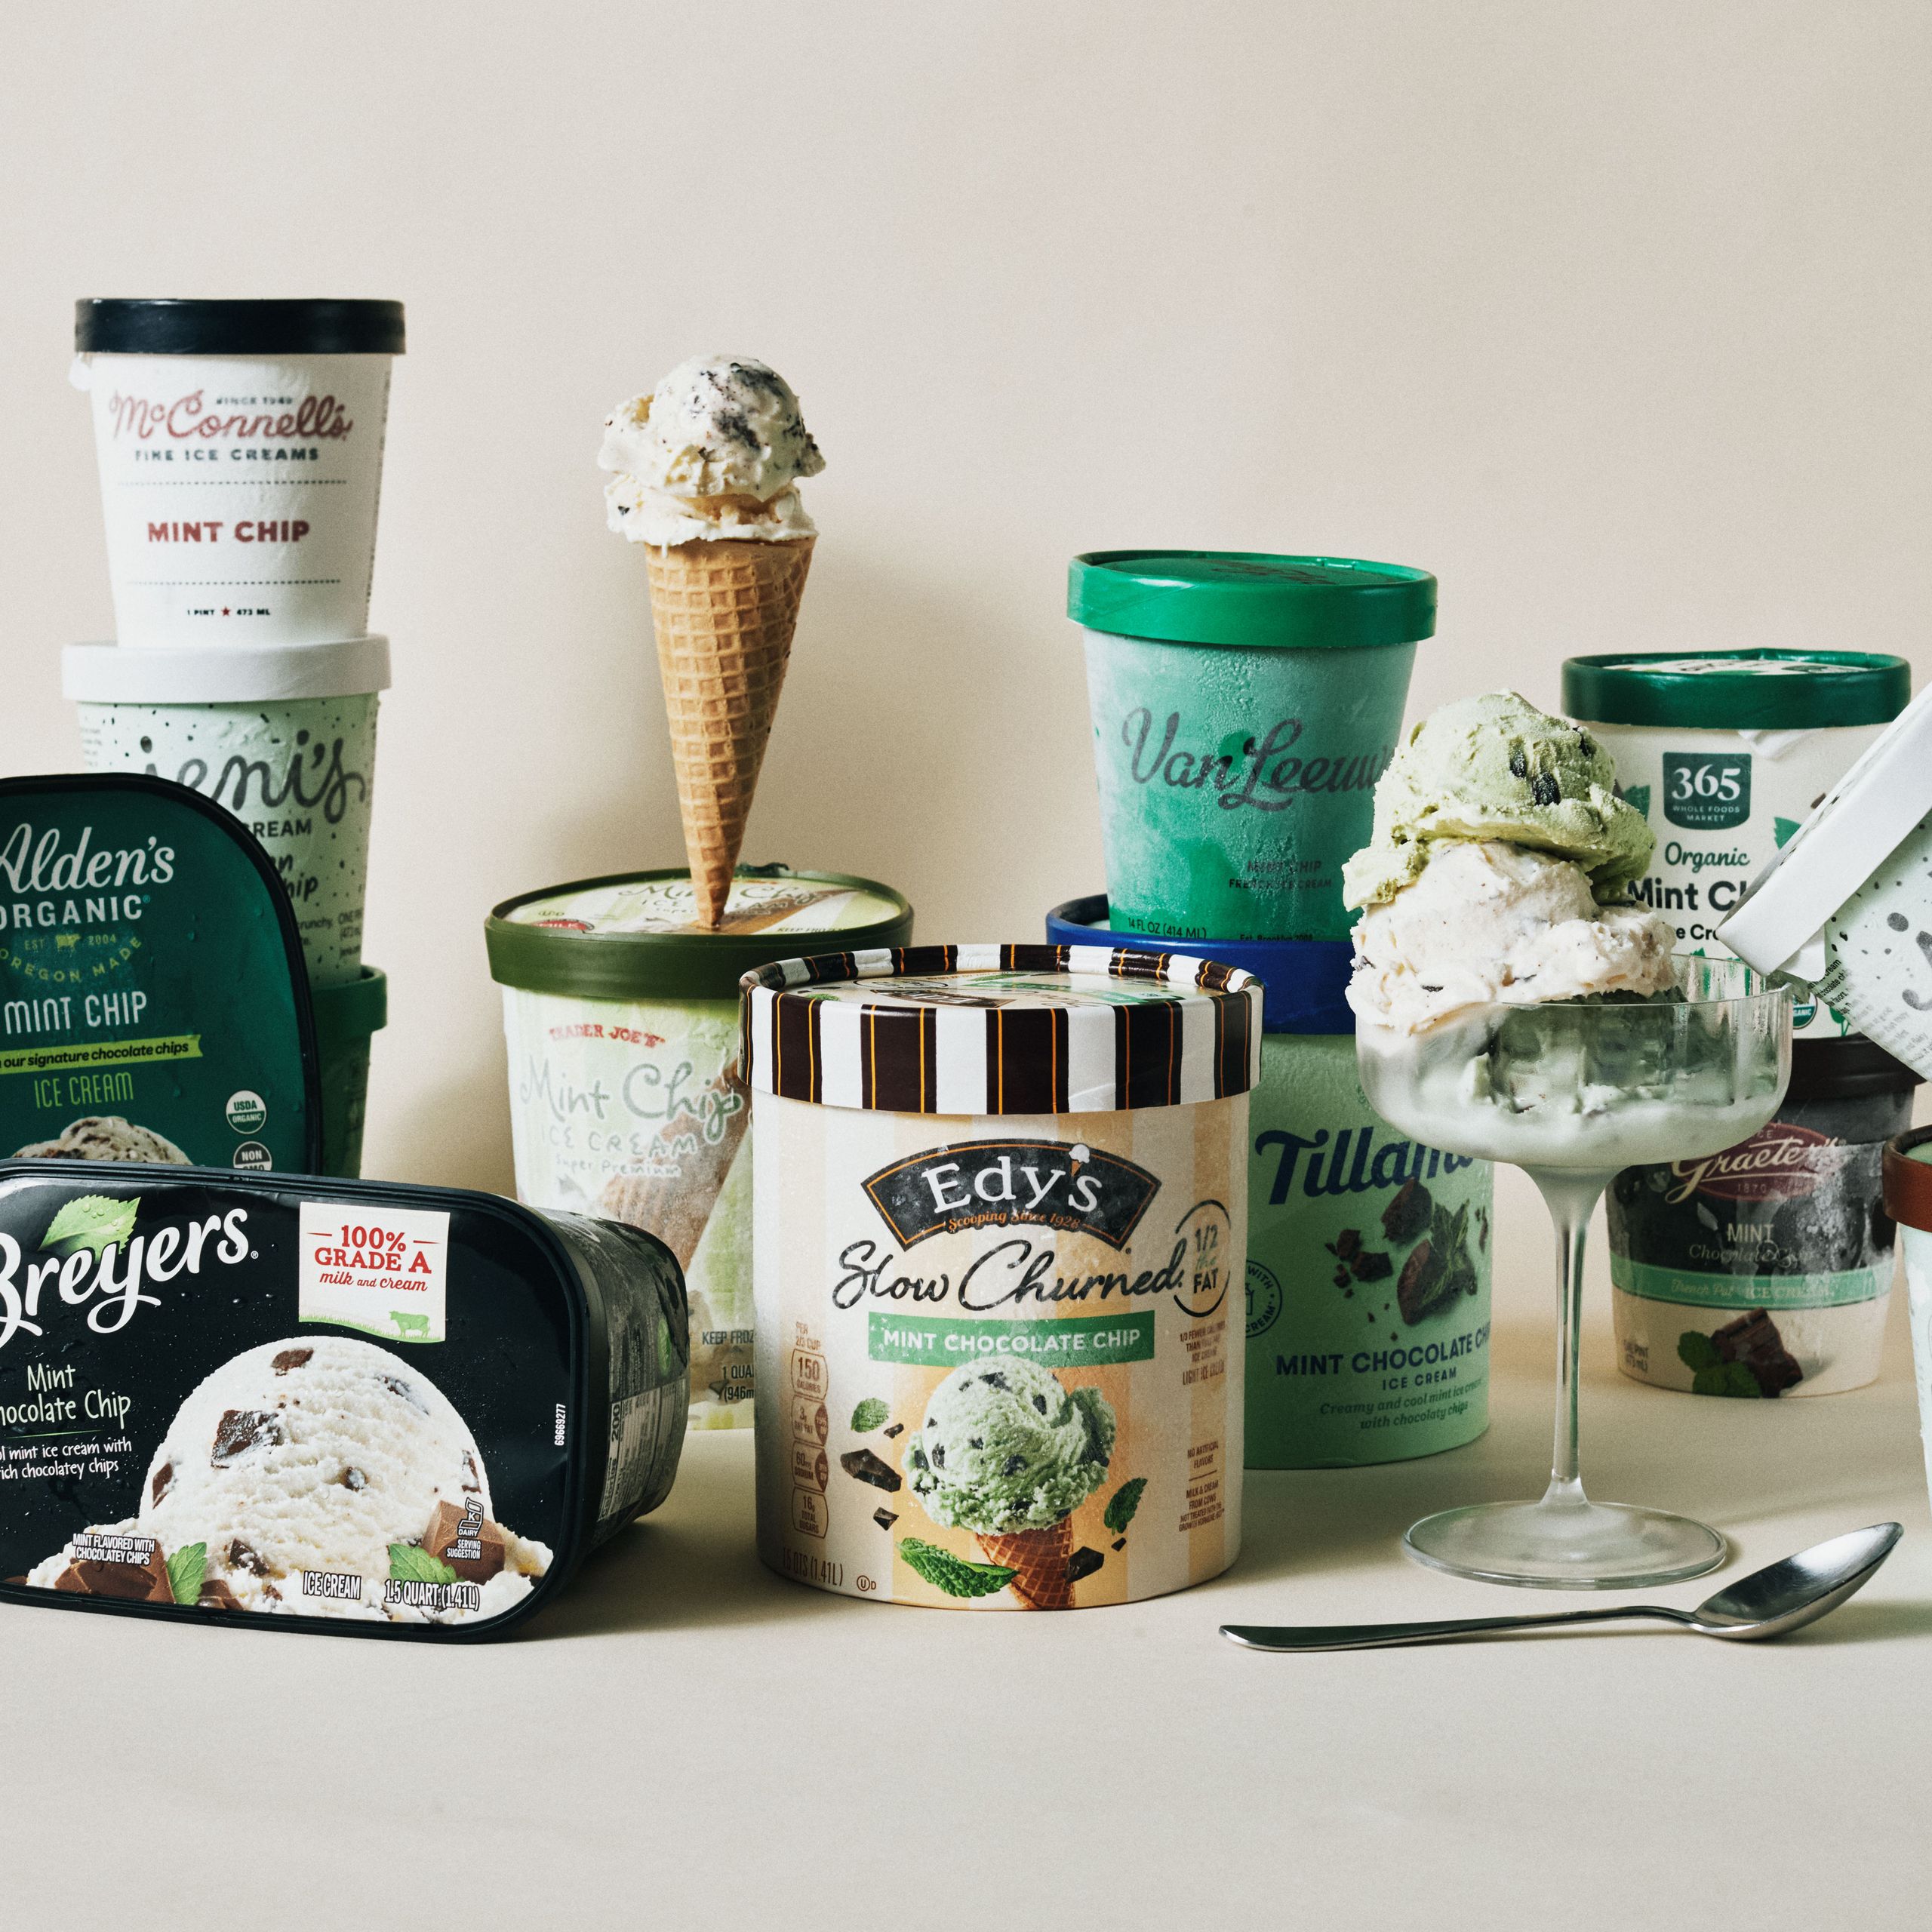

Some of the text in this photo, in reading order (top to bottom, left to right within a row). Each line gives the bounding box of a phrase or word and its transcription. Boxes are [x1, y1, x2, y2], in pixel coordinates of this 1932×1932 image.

[135, 448, 318, 461] FINE ICE CREAMS
[148, 521, 310, 542] MINT CHIP
[1122, 707, 1395, 812] Van Leeuw
[1672, 764, 1741, 801] 365
[0, 823, 175, 894] Alden's
[1665, 841, 1750, 873] Organic
[282, 876, 318, 902] hip
[1298, 878, 1332, 889] CREAM
[1627, 878, 1698, 910] Mint
[1128, 917, 1183, 938] 14 FL OZ (414
[24, 934, 117, 951] EST 2004
[92, 937, 142, 977] MADE
[5, 991, 147, 1034] MINT CHIP
[549, 1024, 604, 1041] TRADER
[4, 1041, 189, 1069] our signature chocolate chips
[34, 1072, 134, 1109] ICE CREAM
[520, 1055, 742, 1143] Mint Chip
[234, 1100, 257, 1111] USDA
[232, 1113, 262, 1123] ORGANIC
[541, 1126, 697, 1157] ICE CREAM
[242, 1150, 262, 1161] NON
[601, 1159, 681, 1175] Premium
[1738, 1184, 1767, 1194] 1870
[949, 1211, 1081, 1230] Scooping Since 1928
[1727, 1223, 1774, 1241] MINT
[342, 1225, 406, 1251] 100%
[1195, 1225, 1218, 1252] 1/2
[315, 1247, 432, 1274] GRADE A
[320, 1271, 428, 1292] milk and cream
[832, 1240, 950, 1309] Slow
[1194, 1268, 1218, 1294] FAT
[1247, 1266, 1274, 1290] WITH
[703, 1331, 727, 1345] KEEP
[808, 1338, 821, 1350] CUP
[884, 1328, 1140, 1353] MINT CHOCOLATE CHIP
[1189, 1327, 1206, 1340] FEWER
[1186, 1341, 1201, 1352] THAN
[1276, 1333, 1472, 1375] MINT CHOCOLATE
[28, 1363, 75, 1392] Mint
[798, 1357, 820, 1381] 150
[1183, 1368, 1198, 1385] LIGHT
[1383, 1367, 1457, 1390] ICE CREAM
[797, 1379, 821, 1393] CALORIES
[85, 1389, 131, 1430] Chip
[1321, 1403, 1374, 1416] Creamy
[1377, 1400, 1401, 1411] and
[1404, 1393, 1427, 1408] cool
[1429, 1390, 1451, 1404] mint
[1361, 1400, 1469, 1429] with chocolaty chips
[554, 1403, 566, 1446] 69669277
[611, 1403, 621, 1441] 200
[9, 1446, 38, 1461] mint
[42, 1444, 58, 1458] ice
[63, 1443, 100, 1457] cream
[103, 1436, 132, 1454] with
[1187, 1440, 1218, 1459] NO ARTIFICIAL
[22, 1457, 118, 1481] chocolatey chips
[1194, 1454, 1214, 1469] FLAVORS
[795, 1466, 814, 1481] SODIUM
[1186, 1480, 1219, 1499] MILK CREAM
[1189, 1493, 1216, 1509] FROM COWS
[800, 1520, 819, 1534] SUGARS
[801, 1510, 816, 1523] TOTAL
[1180, 1513, 1189, 1523] NOT
[1190, 1509, 1206, 1520] TREATED
[73, 1534, 155, 1552] MINT FLAVORED WITH
[447, 1548, 481, 1560] SUGGESTION
[457, 1539, 481, 1549] SERVING
[75, 1547, 151, 1565] CHOCOLATEY CHIPS
[811, 1556, 843, 1586] (1.41L)
[303, 1571, 361, 1599] ICE CREAM
[403, 1581, 440, 1607] QUART
[441, 1583, 480, 1611] (1.41L)
